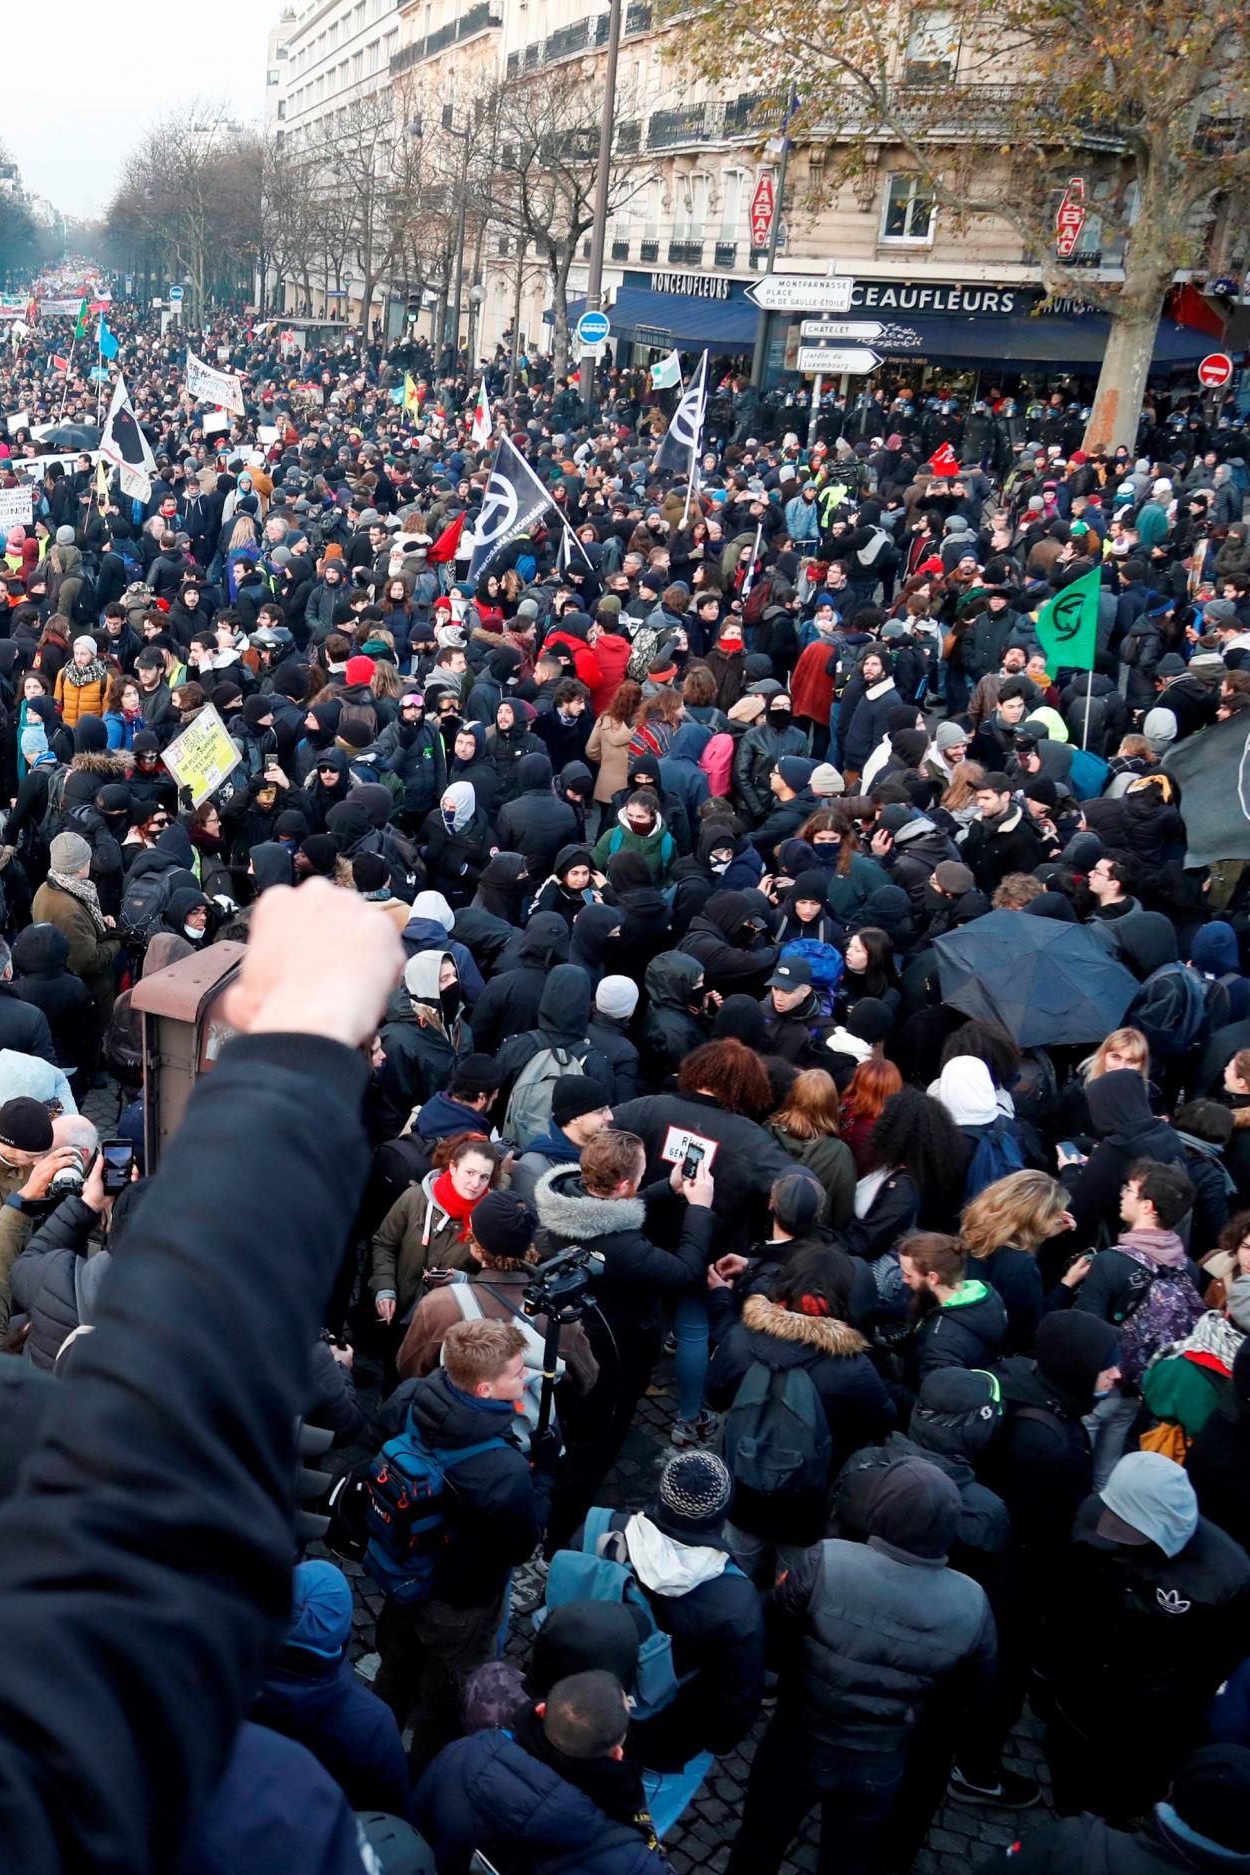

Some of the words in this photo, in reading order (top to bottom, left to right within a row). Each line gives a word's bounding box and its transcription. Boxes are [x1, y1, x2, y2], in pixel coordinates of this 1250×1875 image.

[753, 177, 771, 244] TABAC
[651, 273, 729, 300] MONCEAUFLEURS
[778, 281, 847, 289] MONTPARNASSE
[803, 361, 849, 370] Luxembourg
[202, 744, 217, 758] NOTRE
[199, 757, 216, 773] PROJET
